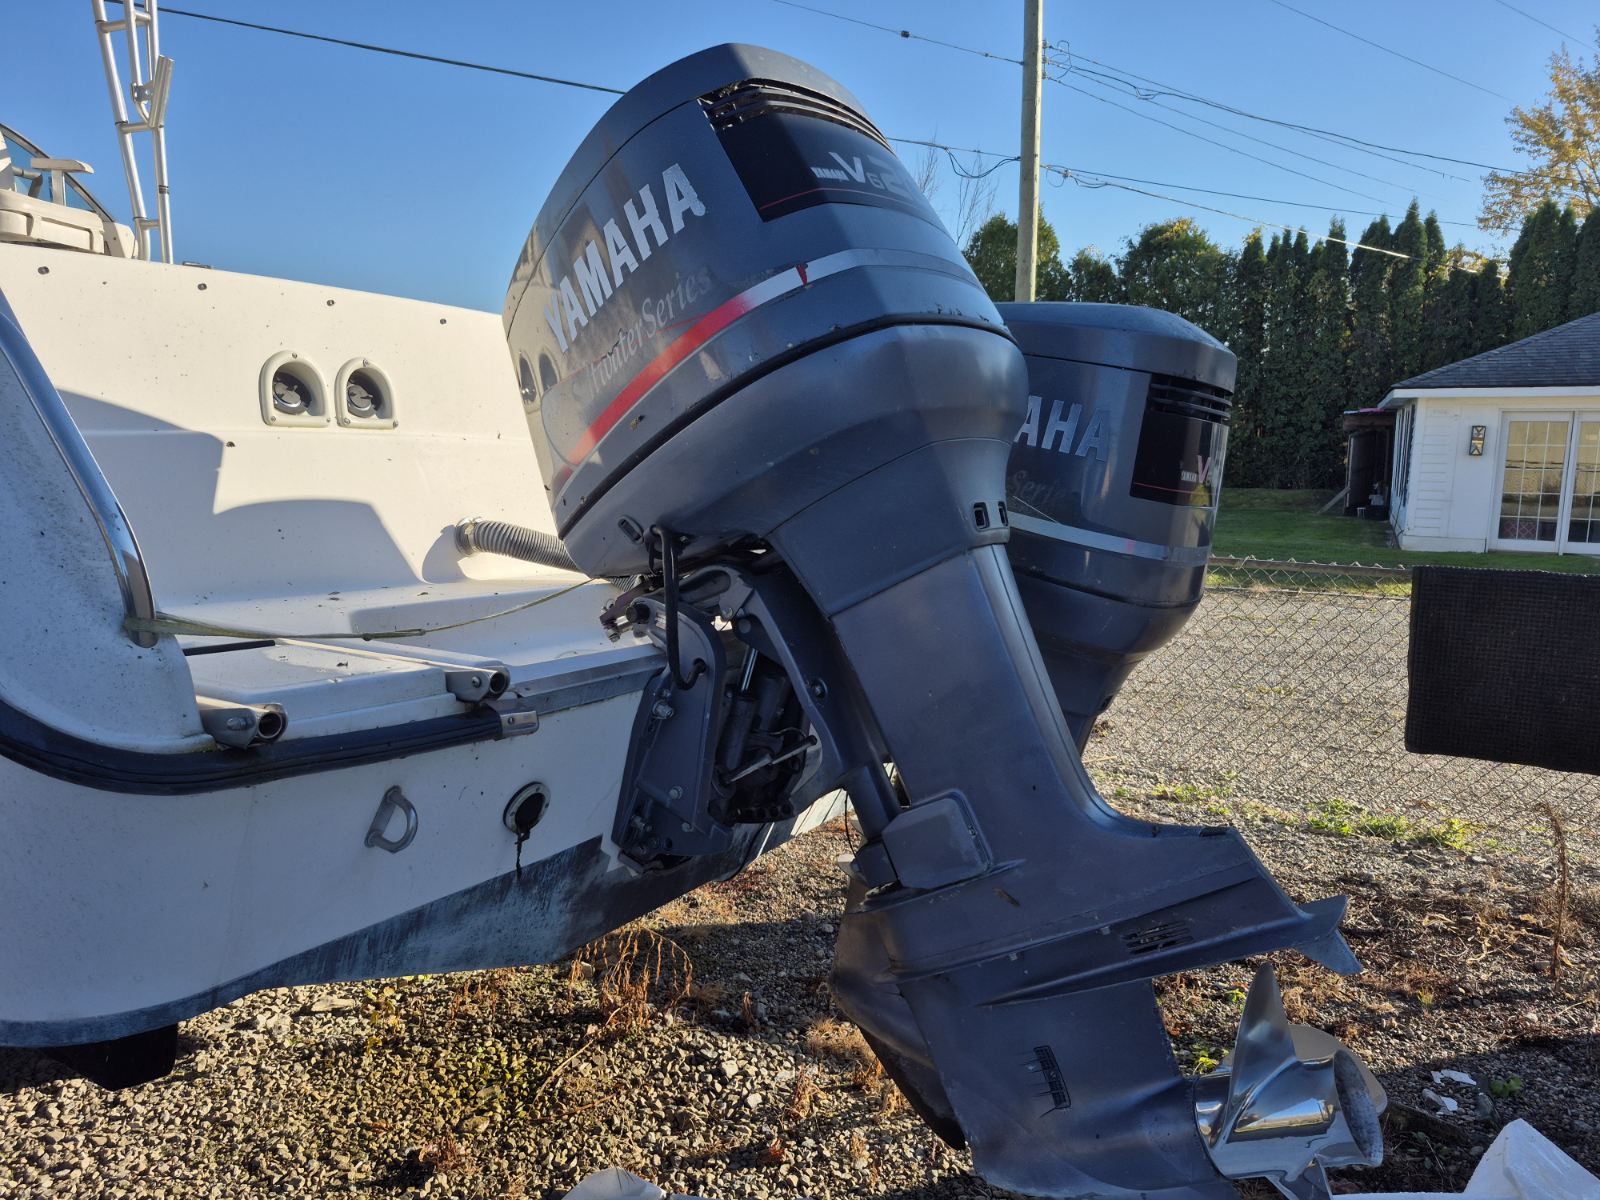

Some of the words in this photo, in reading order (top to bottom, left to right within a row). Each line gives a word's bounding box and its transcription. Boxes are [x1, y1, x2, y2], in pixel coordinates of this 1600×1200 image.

[543, 163, 706, 354] YAMAHA
[641, 268, 712, 338] Series
[1014, 395, 1109, 461] AHA
